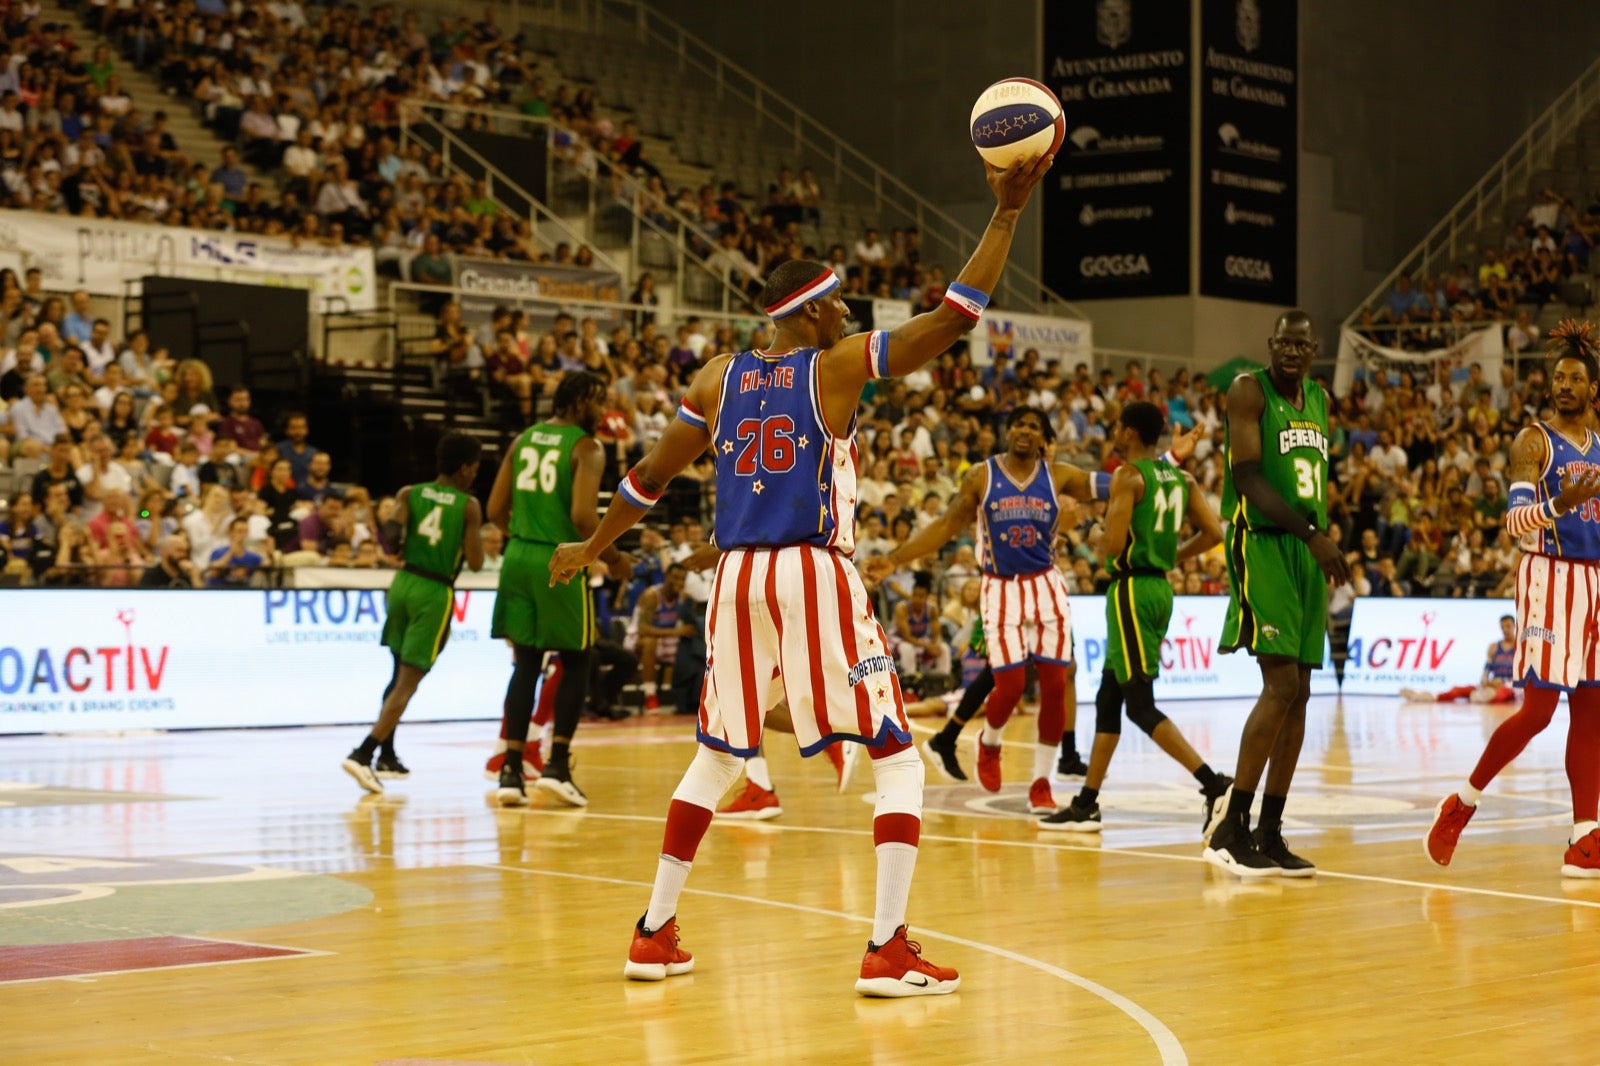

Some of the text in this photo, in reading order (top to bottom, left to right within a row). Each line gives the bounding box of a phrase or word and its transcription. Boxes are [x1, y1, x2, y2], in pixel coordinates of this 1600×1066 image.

[1052, 49, 1184, 77] AYUNTAMIENTO
[1205, 47, 1294, 84] AYUNTAMIENTO
[1061, 77, 1172, 101] DE GRANADA
[1212, 76, 1287, 107] DE GRANADA
[1080, 254, 1151, 277] GOGSA
[1224, 255, 1273, 281] GOGSA
[735, 413, 796, 476] 26
[516, 446, 561, 494] 26
[1293, 457, 1322, 503] 31
[999, 495, 1045, 511] HARLEM
[1153, 484, 1184, 533] 11
[417, 505, 443, 547] 4
[1008, 524, 1037, 548] 23
